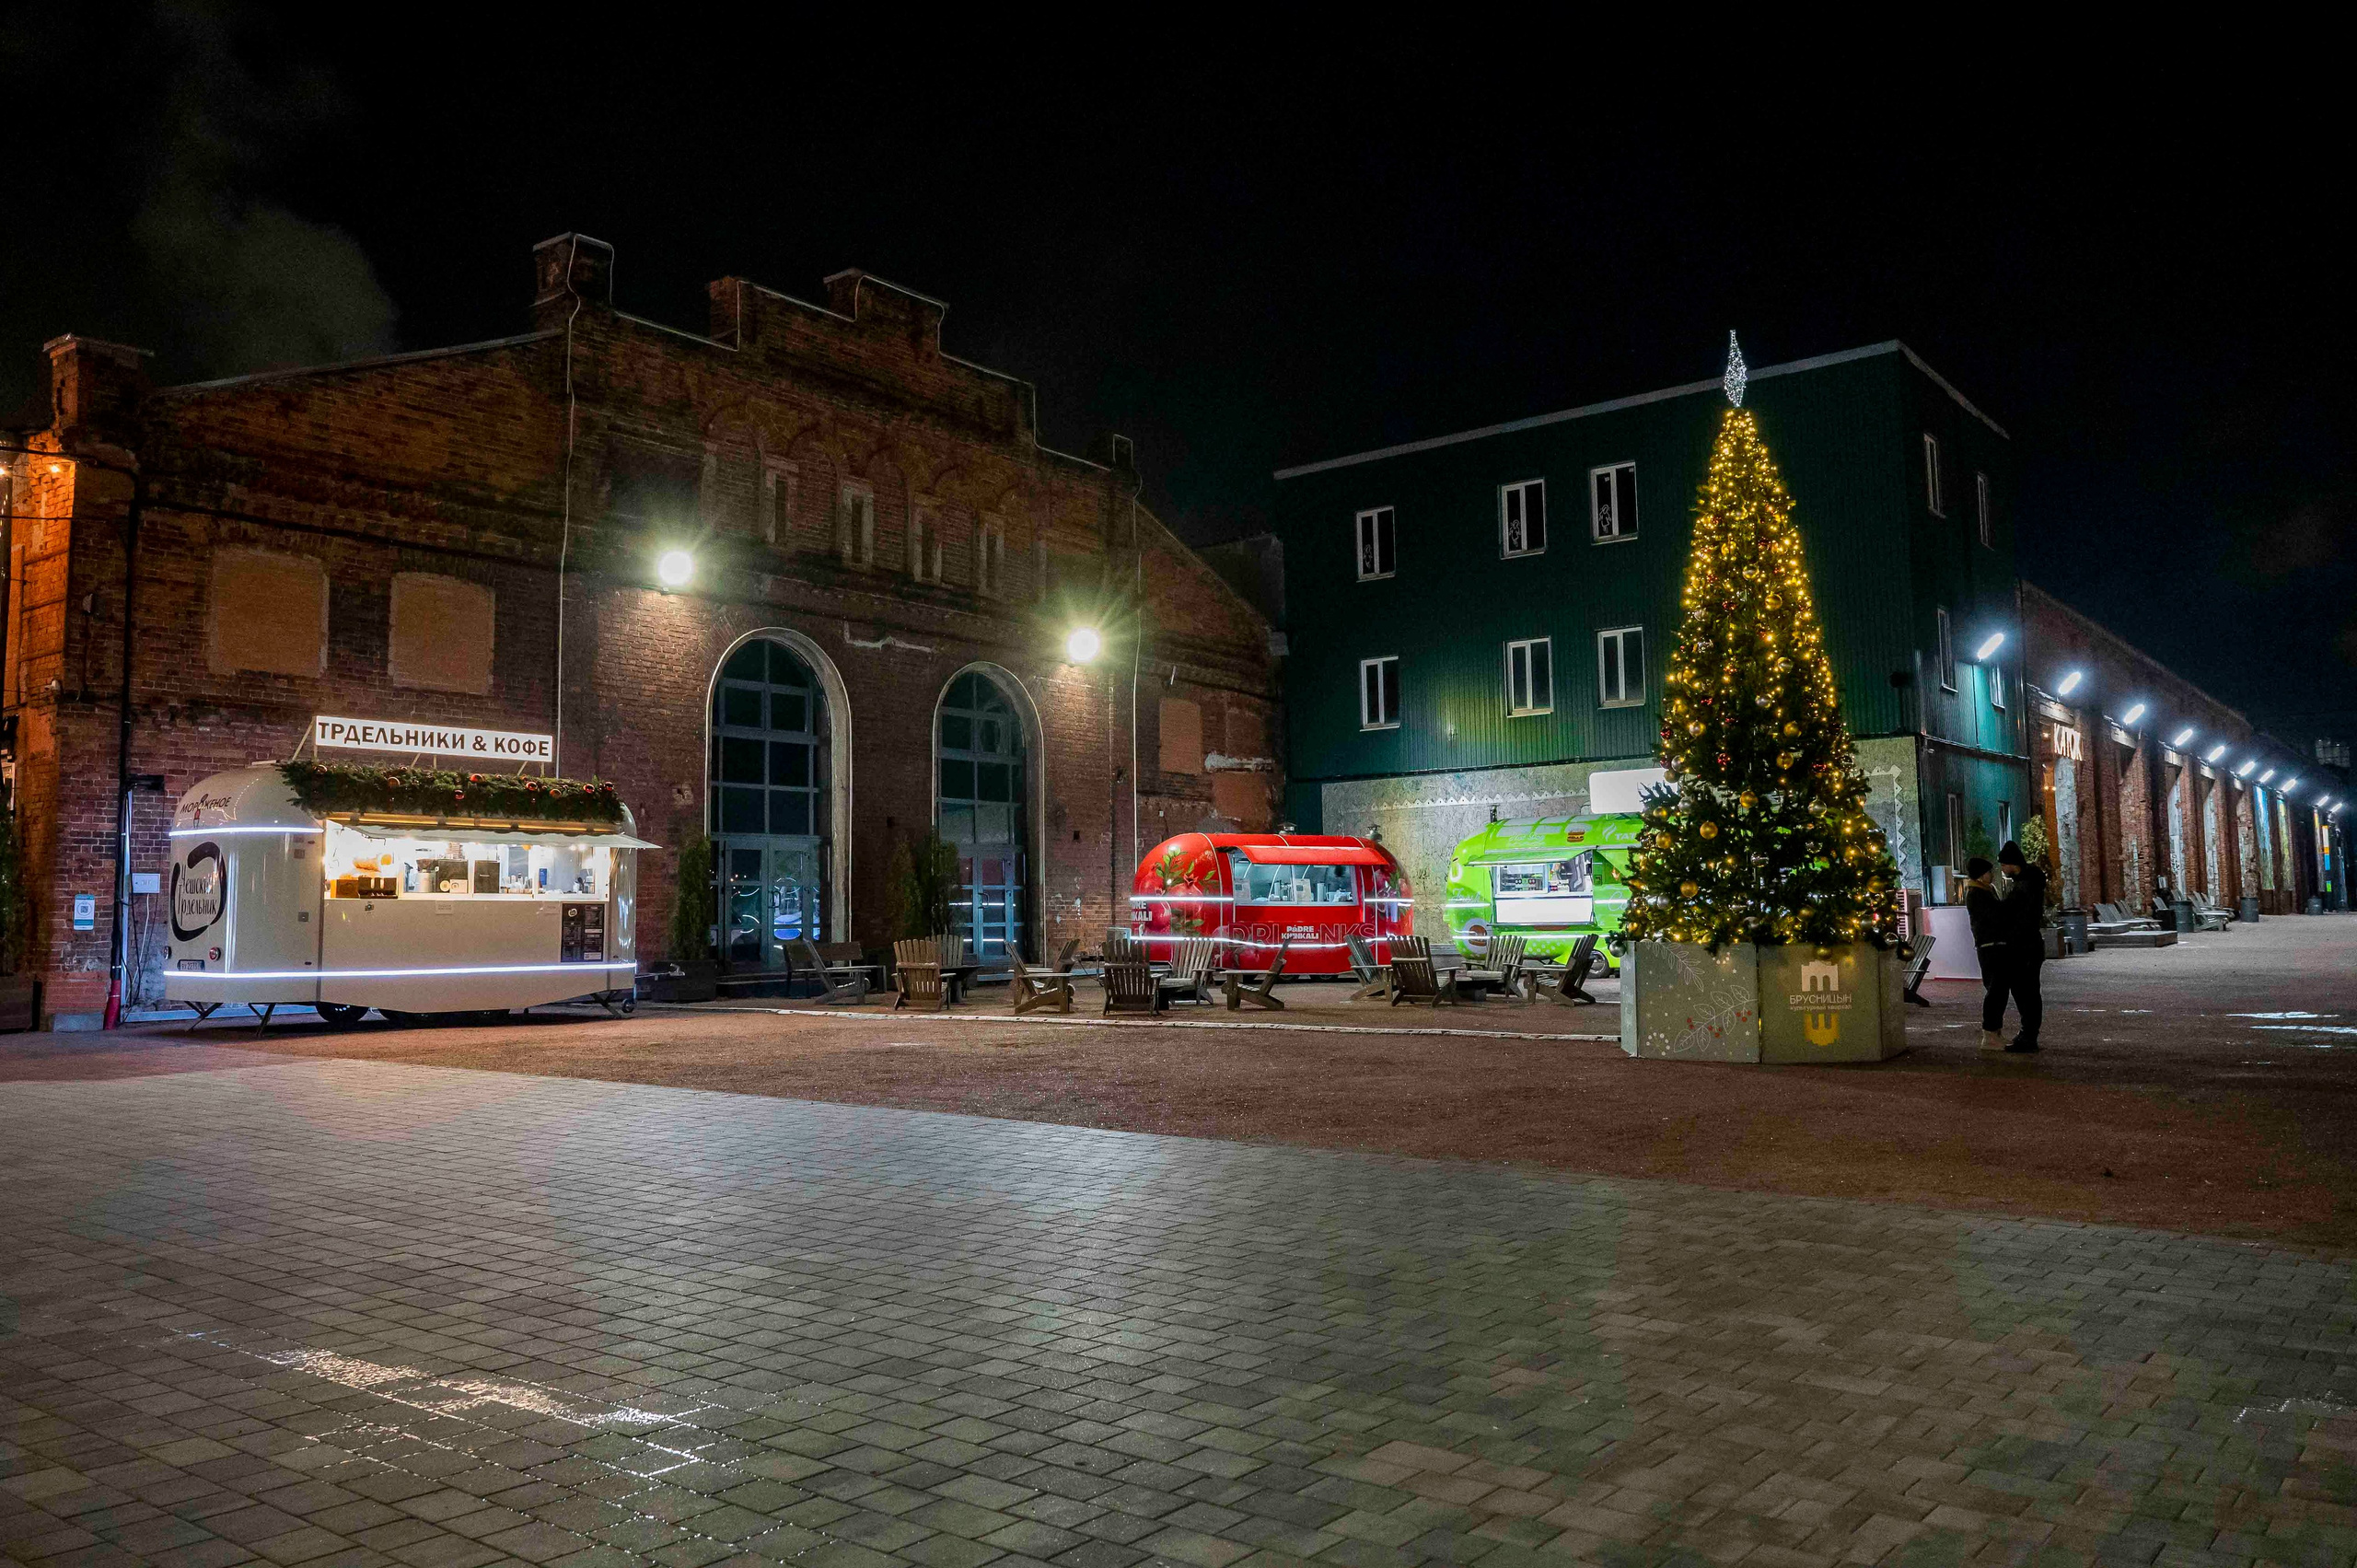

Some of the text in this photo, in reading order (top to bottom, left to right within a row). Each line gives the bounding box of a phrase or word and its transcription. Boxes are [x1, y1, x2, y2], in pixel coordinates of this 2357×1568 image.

[318, 722, 549, 757] ТРДЕЛЬНИКИ & КОФЕ
[2053, 723, 2083, 761] КАТОК
[180, 796, 232, 814] МОРОЖЕНОЕ
[178, 885, 216, 926] Трдельник
[1789, 993, 1852, 1005] БРУСНИЦЫН
